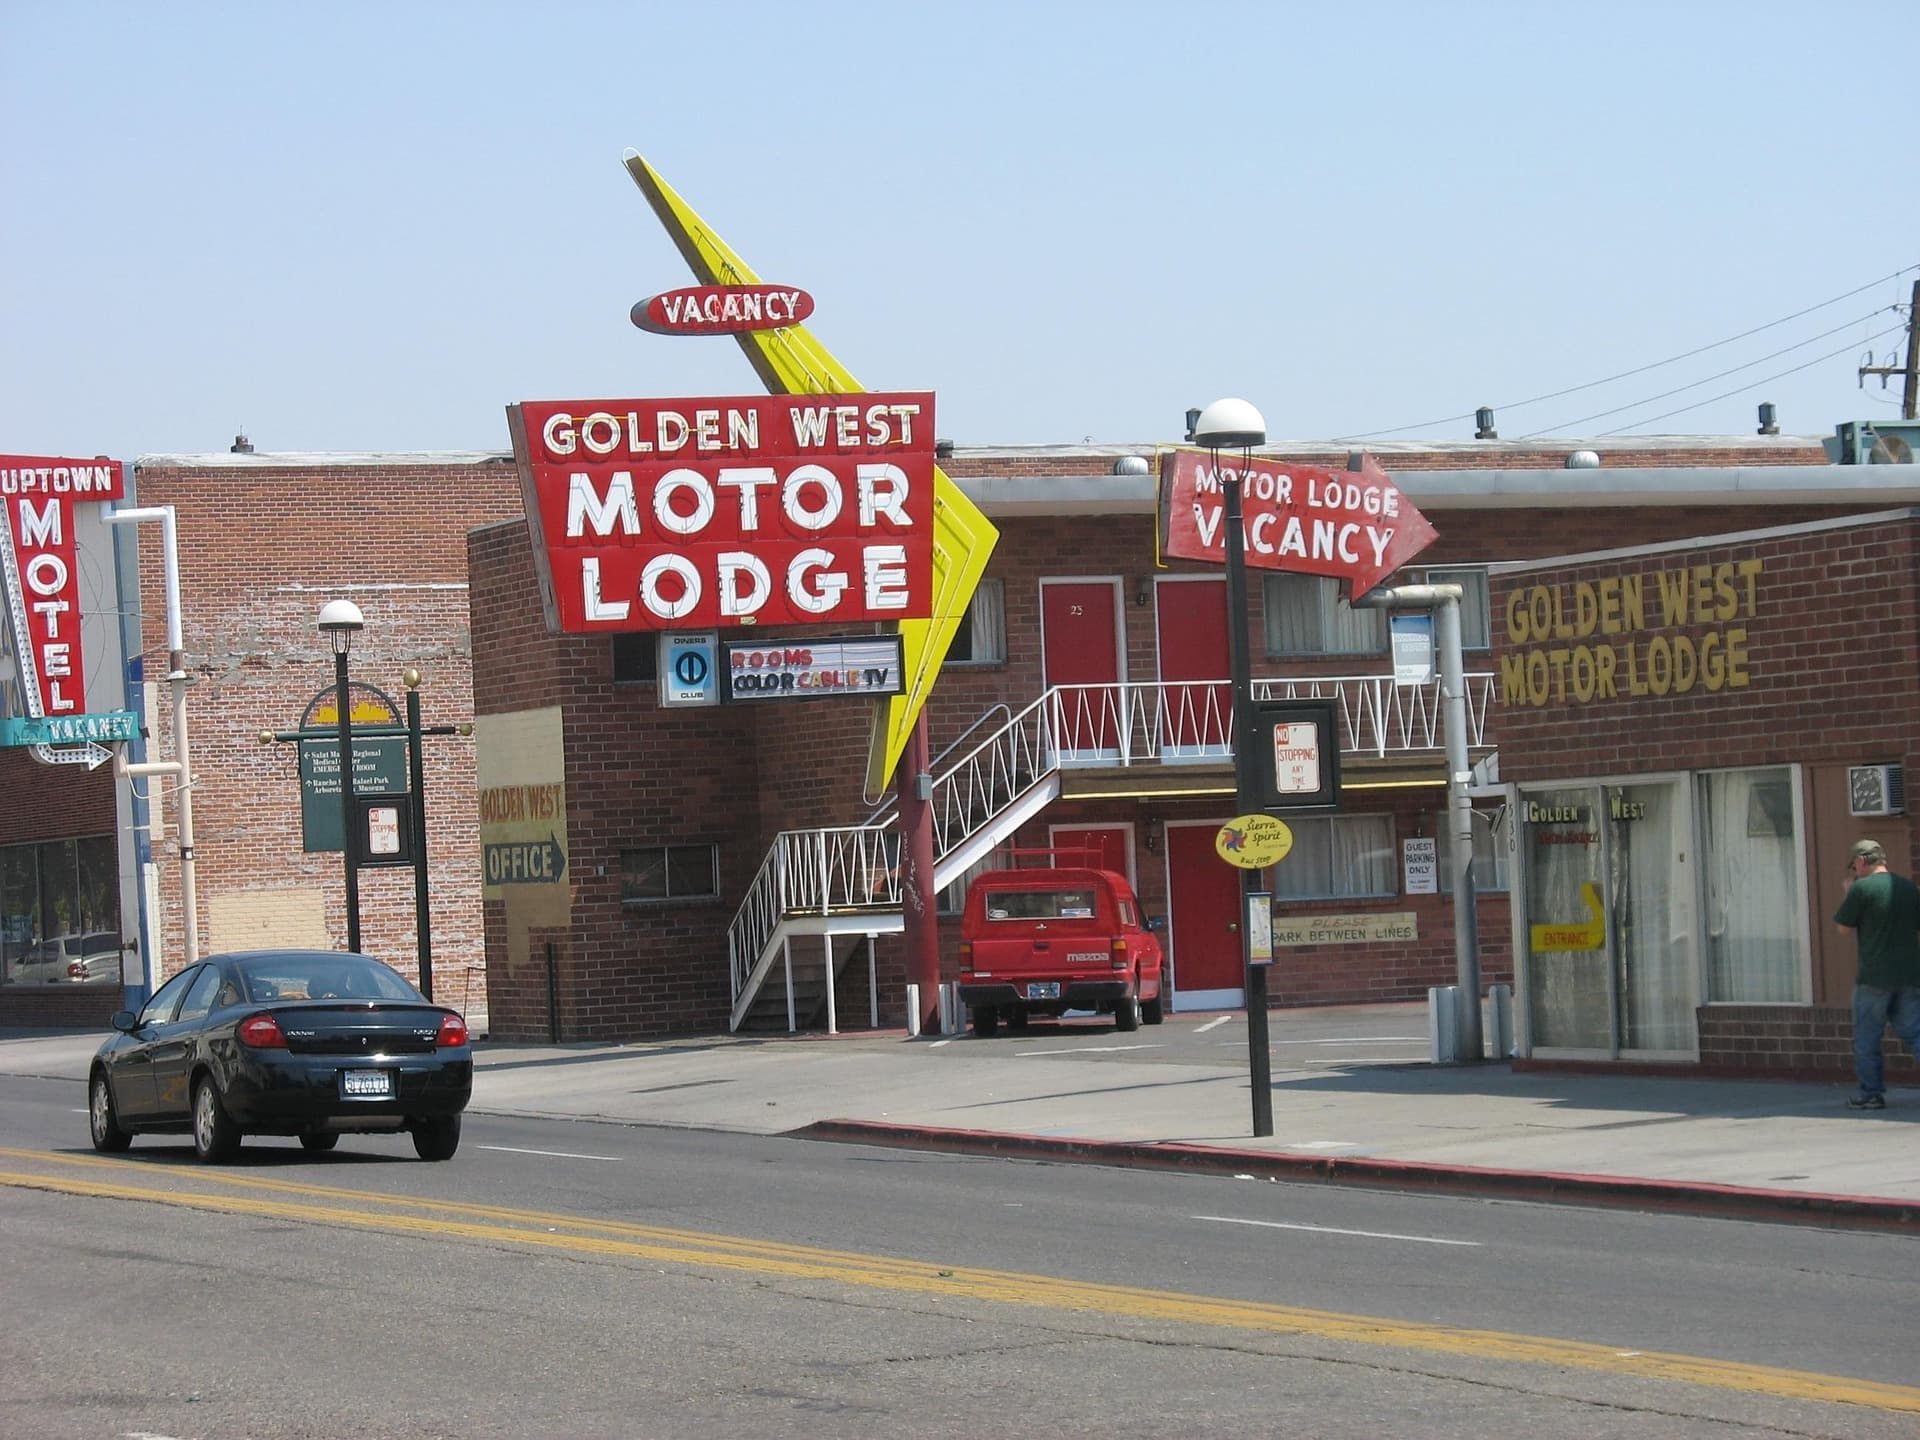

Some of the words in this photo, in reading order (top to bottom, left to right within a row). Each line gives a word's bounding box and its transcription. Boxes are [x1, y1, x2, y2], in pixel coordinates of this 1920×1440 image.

[661, 292, 801, 324] VACANCY
[543, 408, 758, 455] GOLDEN
[790, 404, 921, 448] WEST
[1, 466, 112, 494] UPTOWN
[566, 463, 915, 538] MOTOR
[1307, 478, 1399, 518] LODGE
[1192, 503, 1395, 567] VCANCY
[582, 545, 910, 621] LODGE
[19, 499, 74, 711] MOTEL
[1507, 575, 1645, 644] GOLDEN
[1658, 559, 1763, 626] WEST
[674, 637, 707, 645] DINERS
[732, 649, 813, 668] ROOMS
[1502, 644, 1618, 708] MOTOR
[1627, 629, 1751, 696] LODGE
[734, 673, 795, 691] COLOR
[797, 670, 860, 688] CABLE
[863, 668, 889, 686] TV
[50, 716, 133, 738] VACANCY
[1277, 728, 1288, 742] NO
[1280, 748, 1315, 761] STOPPING
[482, 787, 525, 823] GOLDEN
[529, 785, 561, 820] WEST
[1529, 801, 1578, 822] GOLDEN
[1611, 797, 1645, 819] WEST
[1246, 820, 1276, 831] Sierra
[1252, 831, 1281, 846] Spirit
[1407, 843, 1432, 851] GUEST
[490, 845, 553, 880] OFFICE
[1406, 854, 1435, 863] PARKING
[1272, 931, 1303, 942] PARK
[1310, 929, 1366, 941] BETWEEN
[1375, 927, 1412, 938] LINES
[1312, 917, 1372, 928] PLEASE
